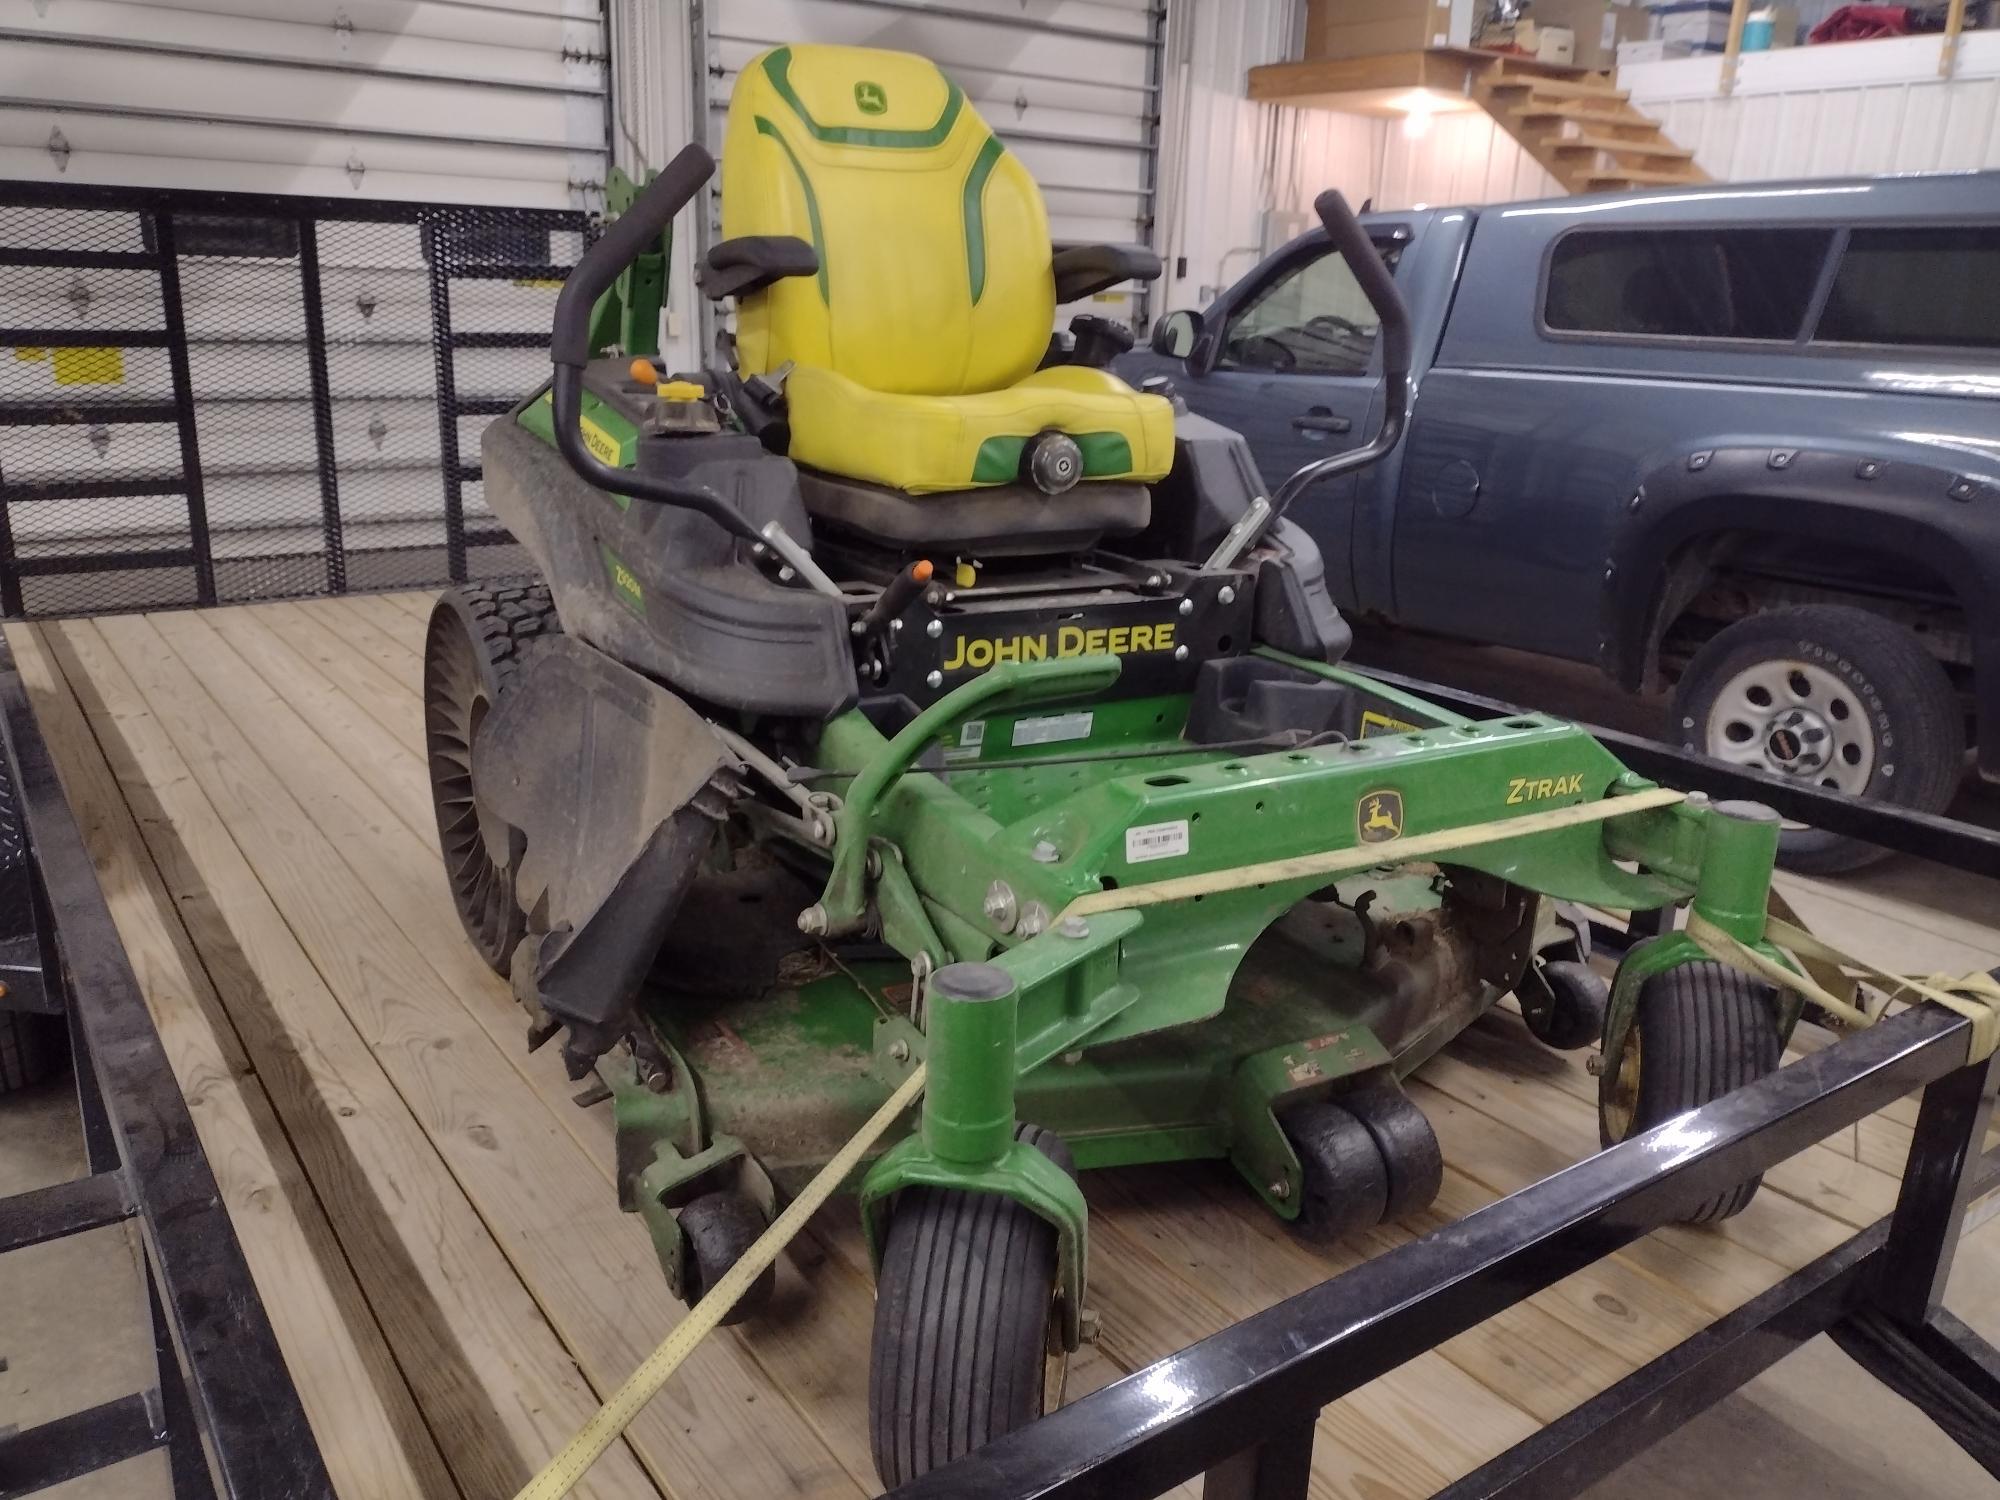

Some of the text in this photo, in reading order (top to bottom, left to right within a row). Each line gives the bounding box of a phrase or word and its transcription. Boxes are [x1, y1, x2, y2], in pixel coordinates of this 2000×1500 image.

[591, 433, 614, 461] DEERE
[943, 623, 1176, 670] JOHN DEERE
[1506, 773, 1584, 805] ZTRAK
